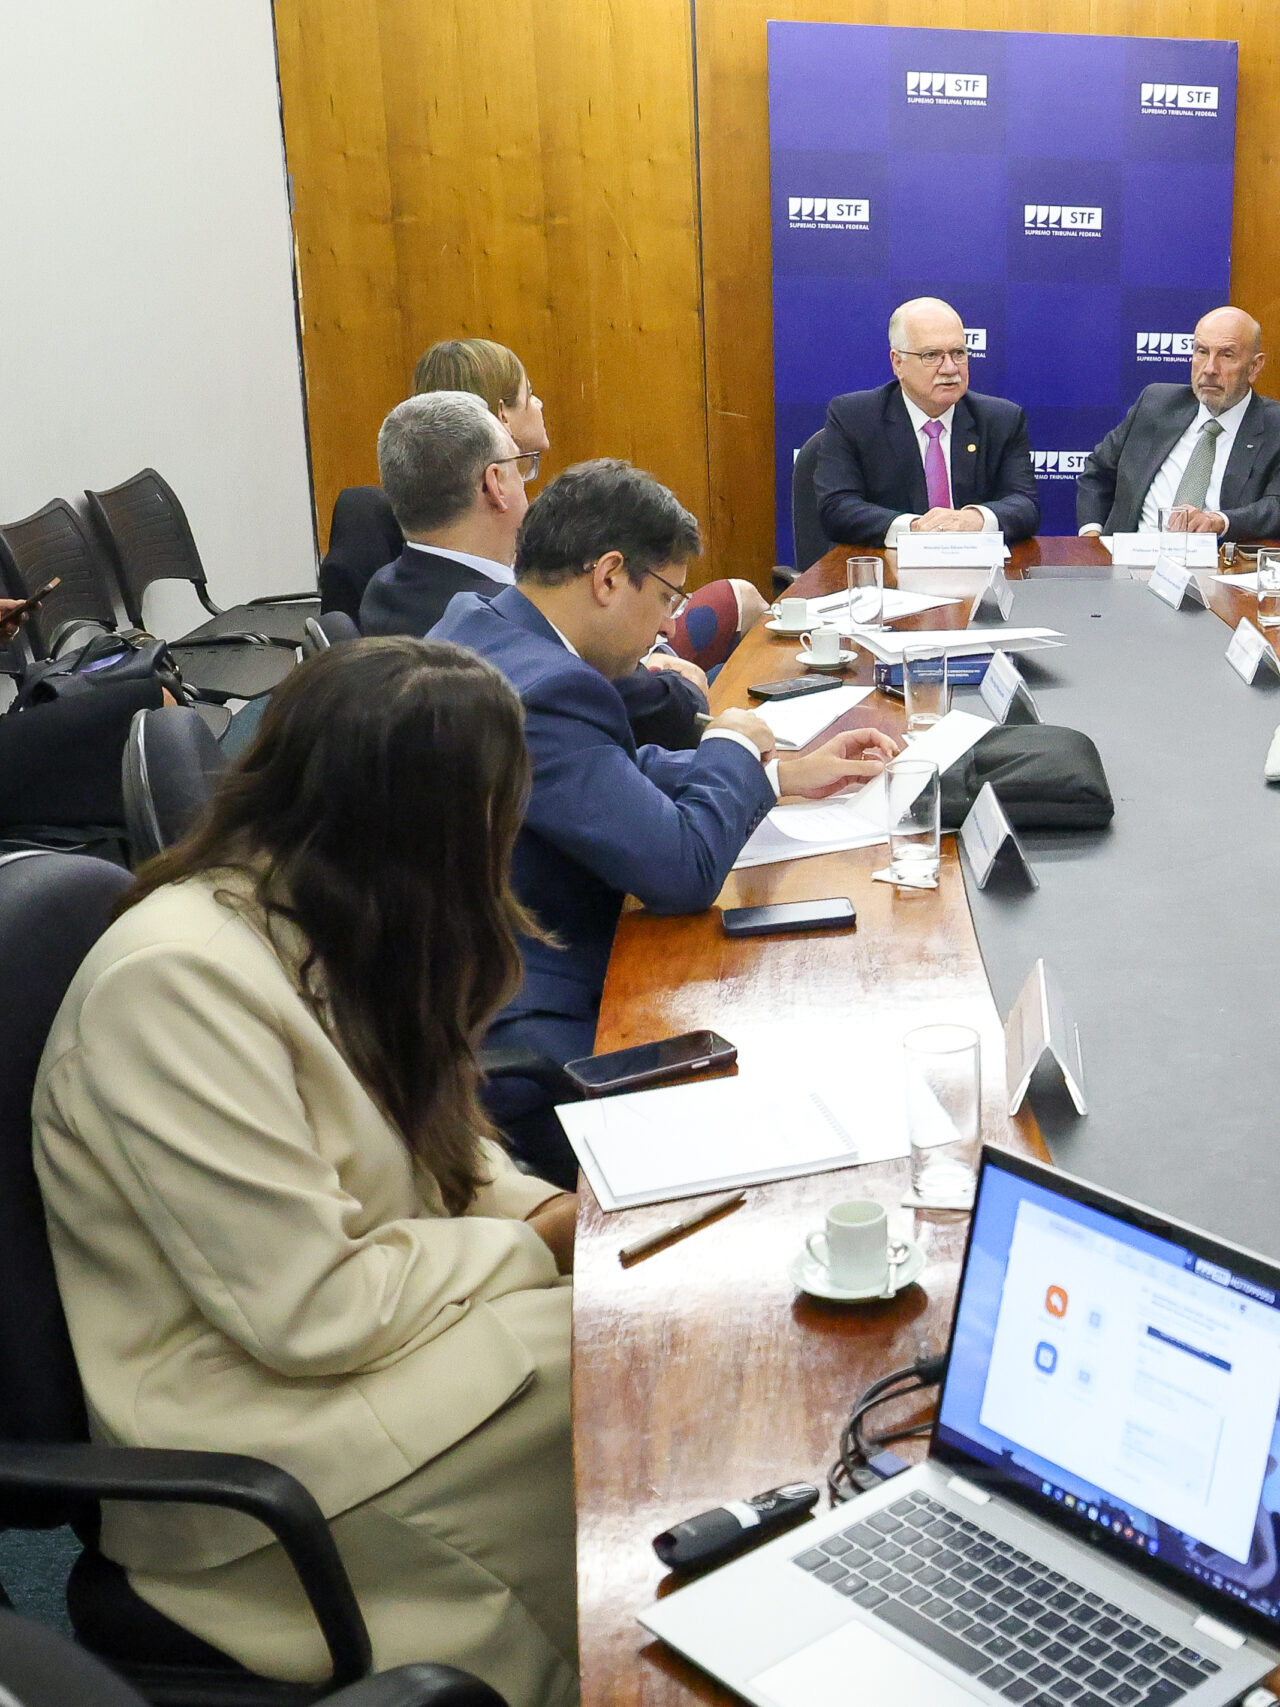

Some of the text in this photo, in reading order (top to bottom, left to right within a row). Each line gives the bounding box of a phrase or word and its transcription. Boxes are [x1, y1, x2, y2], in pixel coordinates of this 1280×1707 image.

[954, 79, 980, 92] STF
[1186, 91, 1211, 103] STF
[836, 204, 862, 216] STF
[1070, 212, 1095, 224] STF
[964, 333, 979, 345] TF
[1181, 338, 1194, 350] ST
[1067, 456, 1086, 468] ST
